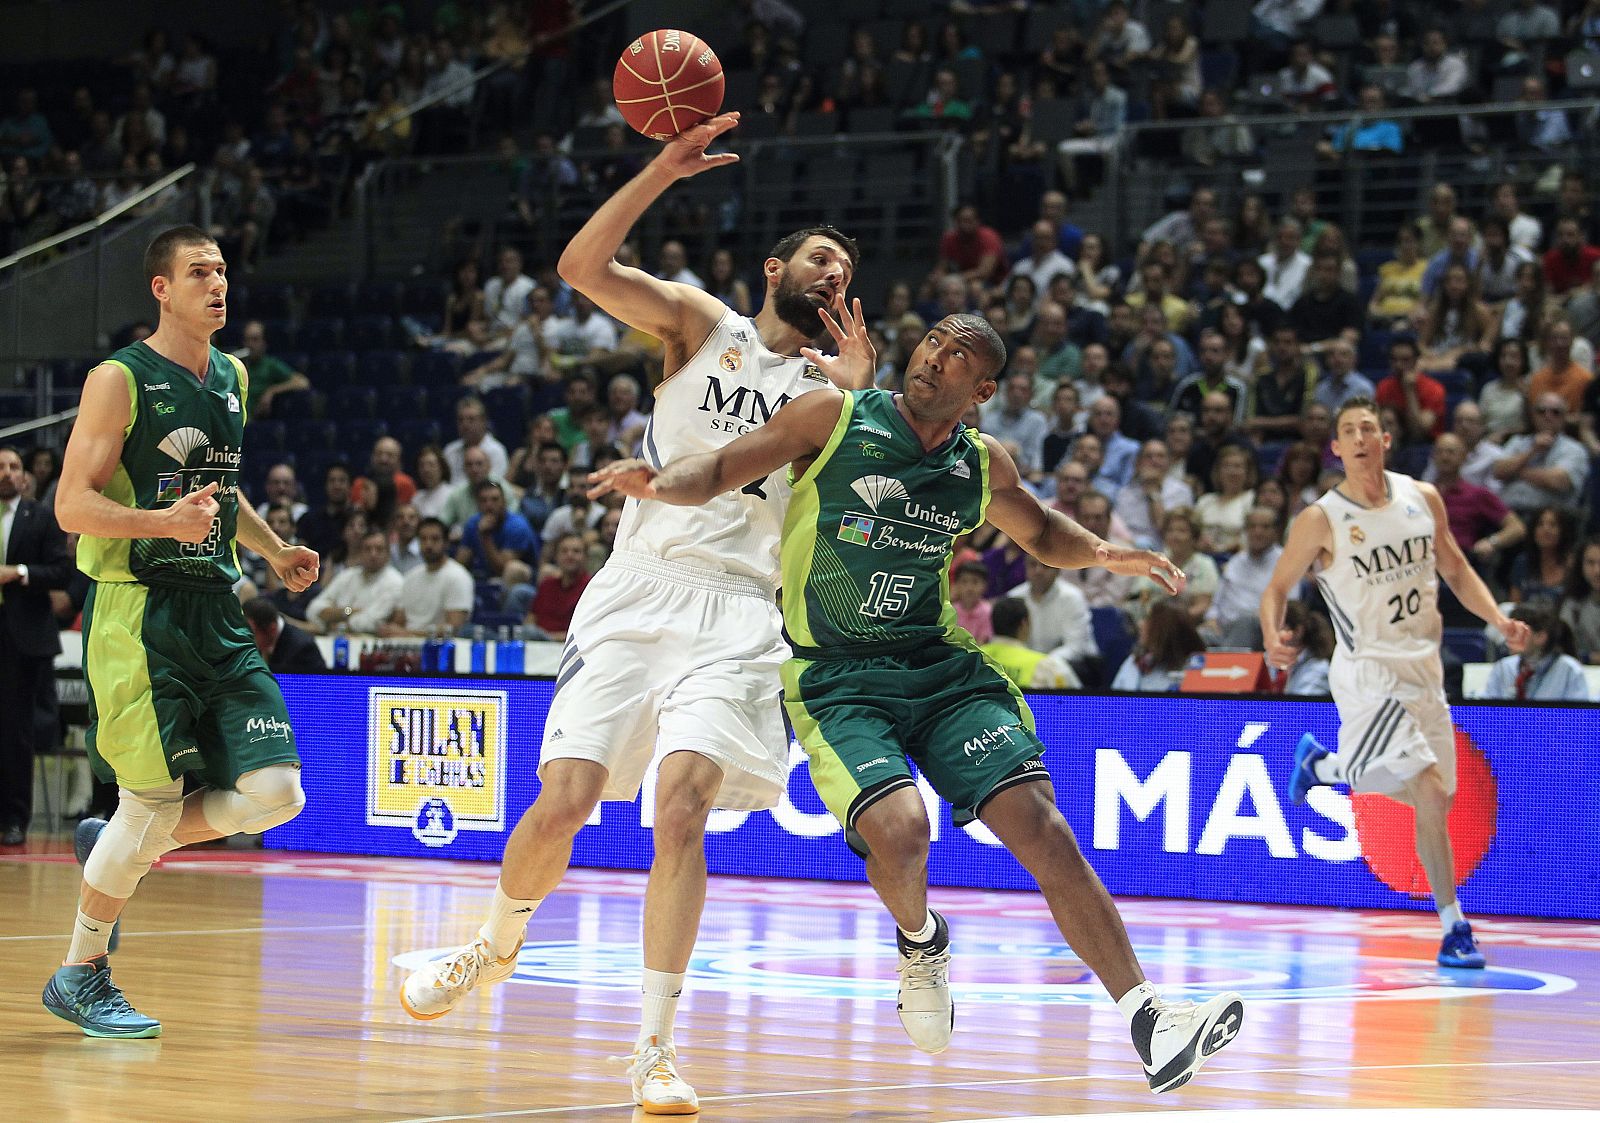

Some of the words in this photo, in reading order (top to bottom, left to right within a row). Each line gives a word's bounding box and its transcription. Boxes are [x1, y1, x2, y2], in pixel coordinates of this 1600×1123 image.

[698, 375, 793, 425] MM
[710, 419, 750, 437] SEG
[859, 425, 892, 439] SPALDING
[904, 501, 960, 532] Unicaja
[1350, 534, 1432, 578] MMT
[858, 570, 915, 619] 15
[1388, 588, 1420, 624] 20
[389, 706, 485, 758] SOLAN
[964, 725, 1015, 757] Málaga
[171, 745, 199, 762] SPALDING
[856, 756, 889, 772] SPALDING
[1022, 760, 1046, 772] SPAL
